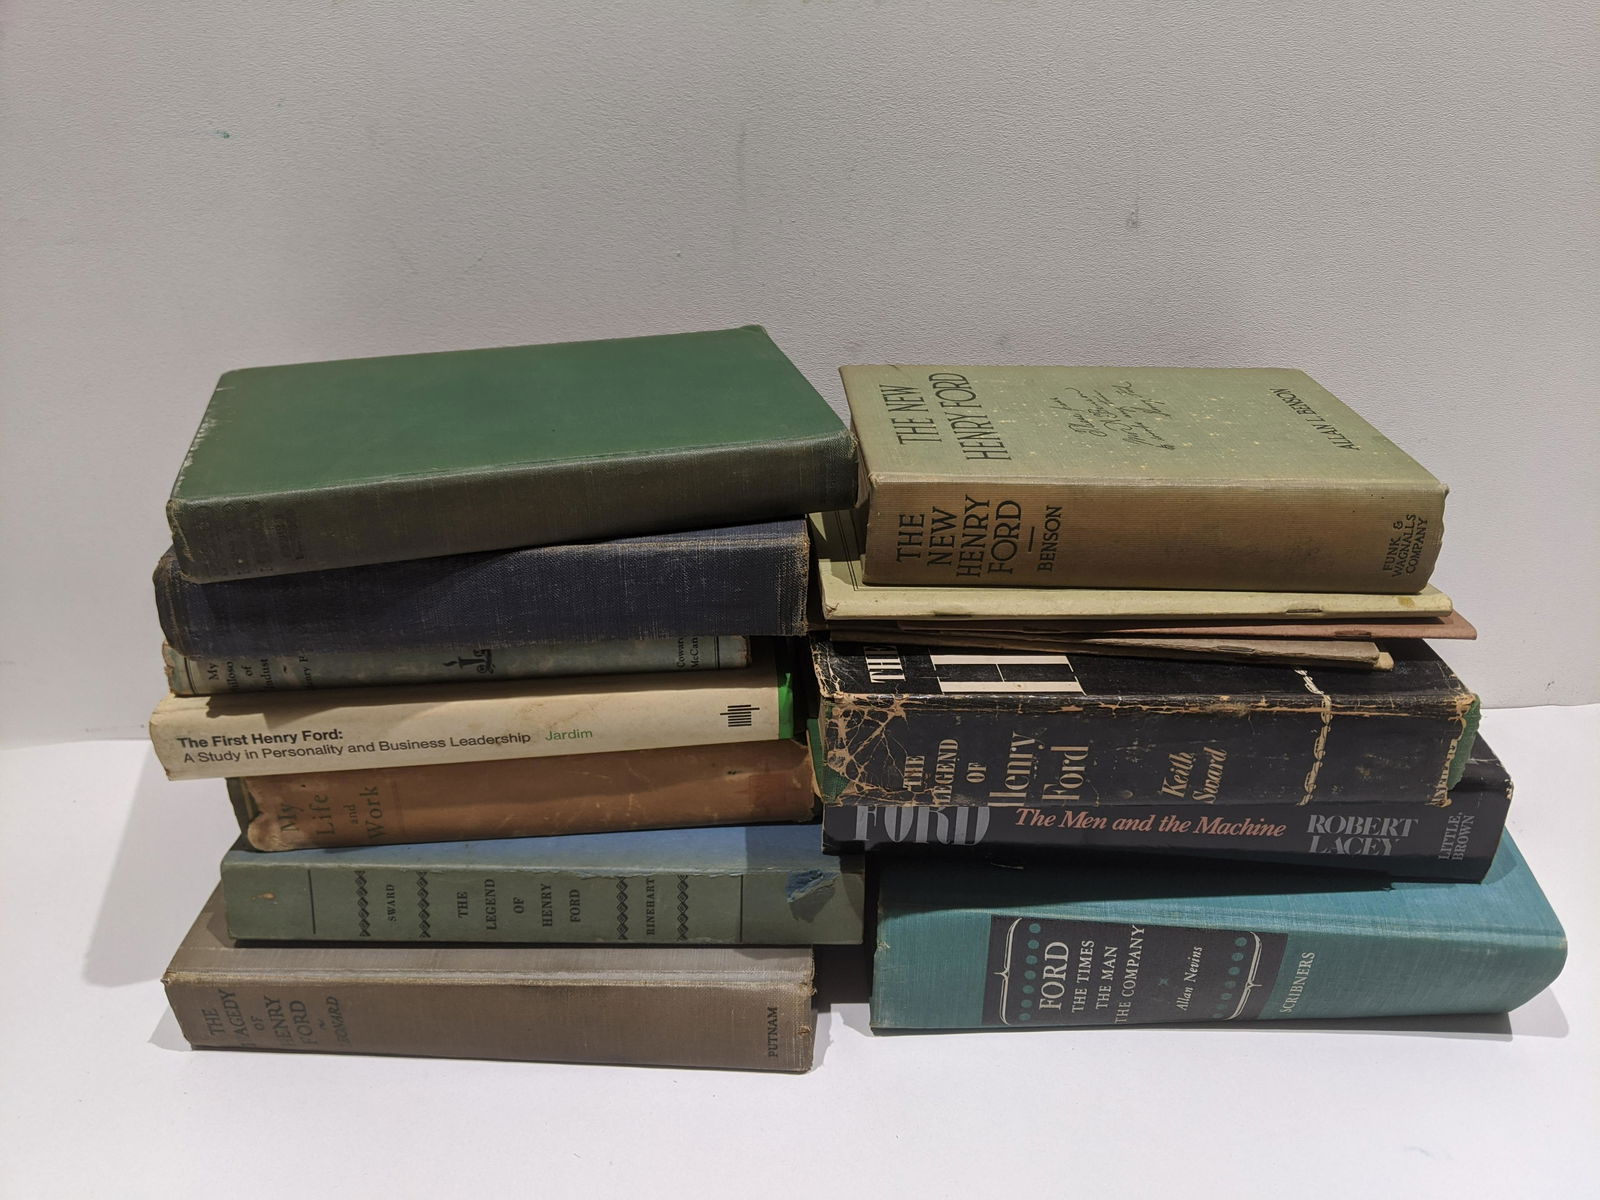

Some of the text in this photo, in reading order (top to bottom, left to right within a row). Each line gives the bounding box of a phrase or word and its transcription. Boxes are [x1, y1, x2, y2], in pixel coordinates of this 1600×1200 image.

[879, 384, 942, 445] THE NEW
[929, 372, 1012, 460] HENRY FORD
[1269, 388, 1317, 415] BENSON
[1312, 423, 1360, 450] ALLAN
[896, 513, 925, 563] THE
[926, 506, 958, 567] NEW
[955, 494, 990, 578] HENRY
[987, 500, 1022, 575] FORD
[1037, 505, 1063, 572] BENSON
[1383, 520, 1403, 571] FUNK &
[1392, 514, 1416, 577] WAGNALLS
[1406, 516, 1428, 574] COMPANY
[207, 662, 219, 681] My
[241, 665, 253, 677] of
[260, 658, 276, 689] Indust
[691, 636, 700, 670] McCan
[177, 728, 343, 749] The First Henry Ford:
[184, 732, 531, 764] A Study in Personality and Business Leadership
[544, 729, 593, 742] Jardim
[903, 755, 925, 789] THE
[966, 762, 987, 783] OF
[987, 730, 1045, 807] Henry
[1041, 746, 1089, 800] Ford
[1161, 751, 1196, 798] Keith
[1192, 746, 1227, 804] Sward
[277, 802, 305, 832] My
[308, 794, 335, 835] Life
[343, 803, 358, 825] and
[360, 785, 385, 839] Work
[853, 805, 990, 846] FORD
[1015, 808, 1287, 837] The Men and the Machine
[1306, 814, 1419, 837] ROBERT
[1308, 835, 1400, 856] LACEY
[1452, 815, 1475, 861] BROWN
[386, 884, 396, 922] SWARD
[457, 890, 469, 918] THE
[484, 878, 497, 931] LEGEND
[513, 896, 525, 914] OF
[540, 883, 553, 927] HENRY
[569, 888, 581, 923] FORD
[646, 878, 655, 936] RINEHART
[1039, 941, 1069, 1011] FORD
[1072, 940, 1095, 1013] THE TIMES
[1096, 946, 1119, 1010] THE MAN
[1114, 925, 1145, 1024] THE COMPANY
[1175, 946, 1203, 1011] Allan Nevins
[1279, 952, 1316, 1014] SCRIBNERS
[202, 1008, 226, 1037] THE
[250, 1015, 265, 1032] OF
[289, 1000, 318, 1045] FORD
[767, 1006, 778, 1058] PUTNAM
